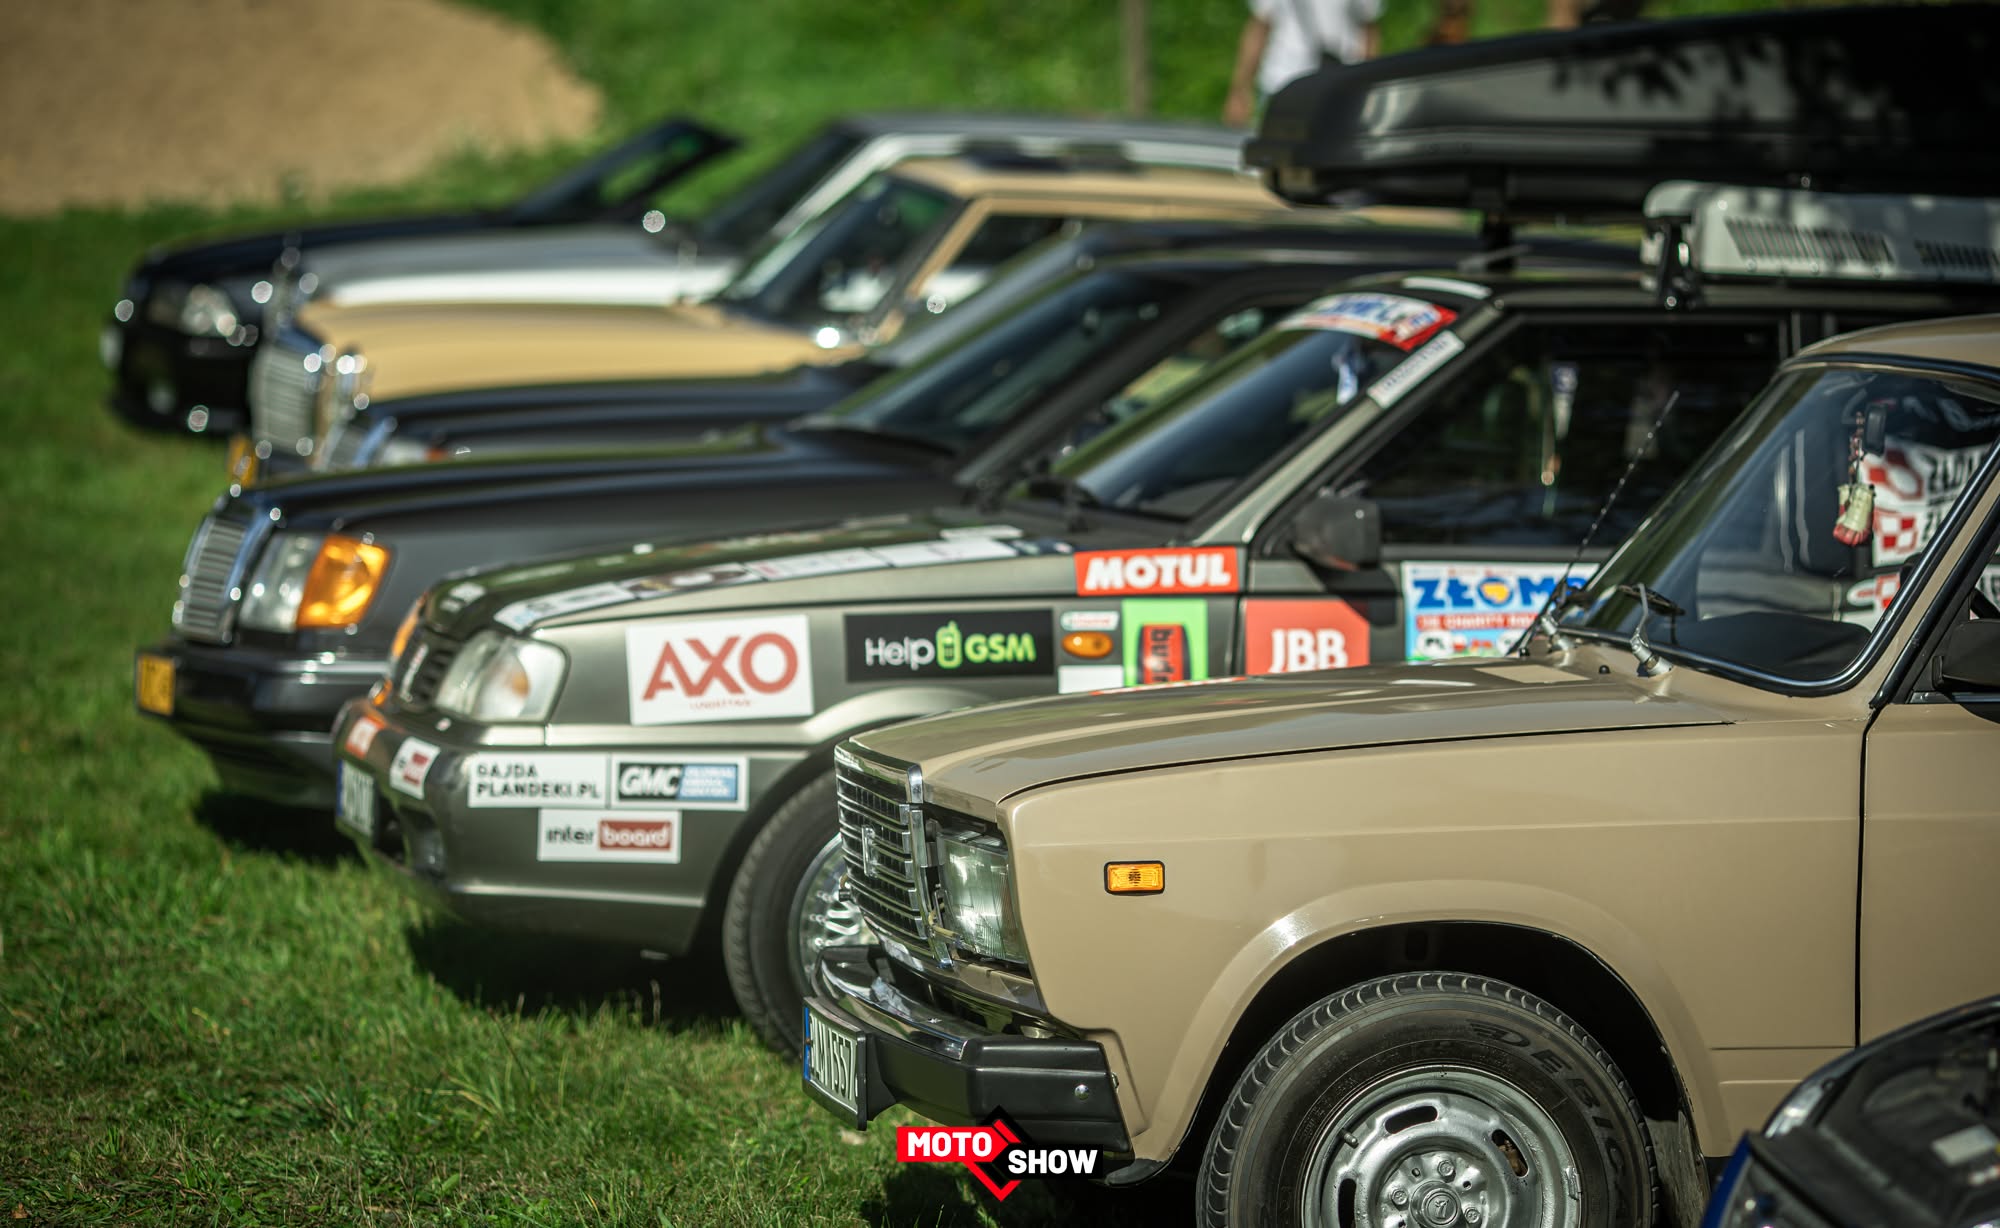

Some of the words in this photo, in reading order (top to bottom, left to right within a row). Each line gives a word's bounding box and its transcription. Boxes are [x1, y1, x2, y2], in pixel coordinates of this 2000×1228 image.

[1084, 554, 1231, 590] MOTUL
[642, 632, 799, 701] AXO
[865, 637, 935, 670] Help
[965, 633, 1037, 663] GSM
[1268, 627, 1348, 673] JBB
[476, 781, 600, 799] PLANDEKI.PL
[619, 766, 681, 797] GMC
[546, 827, 594, 843] inter
[602, 822, 669, 847] board
